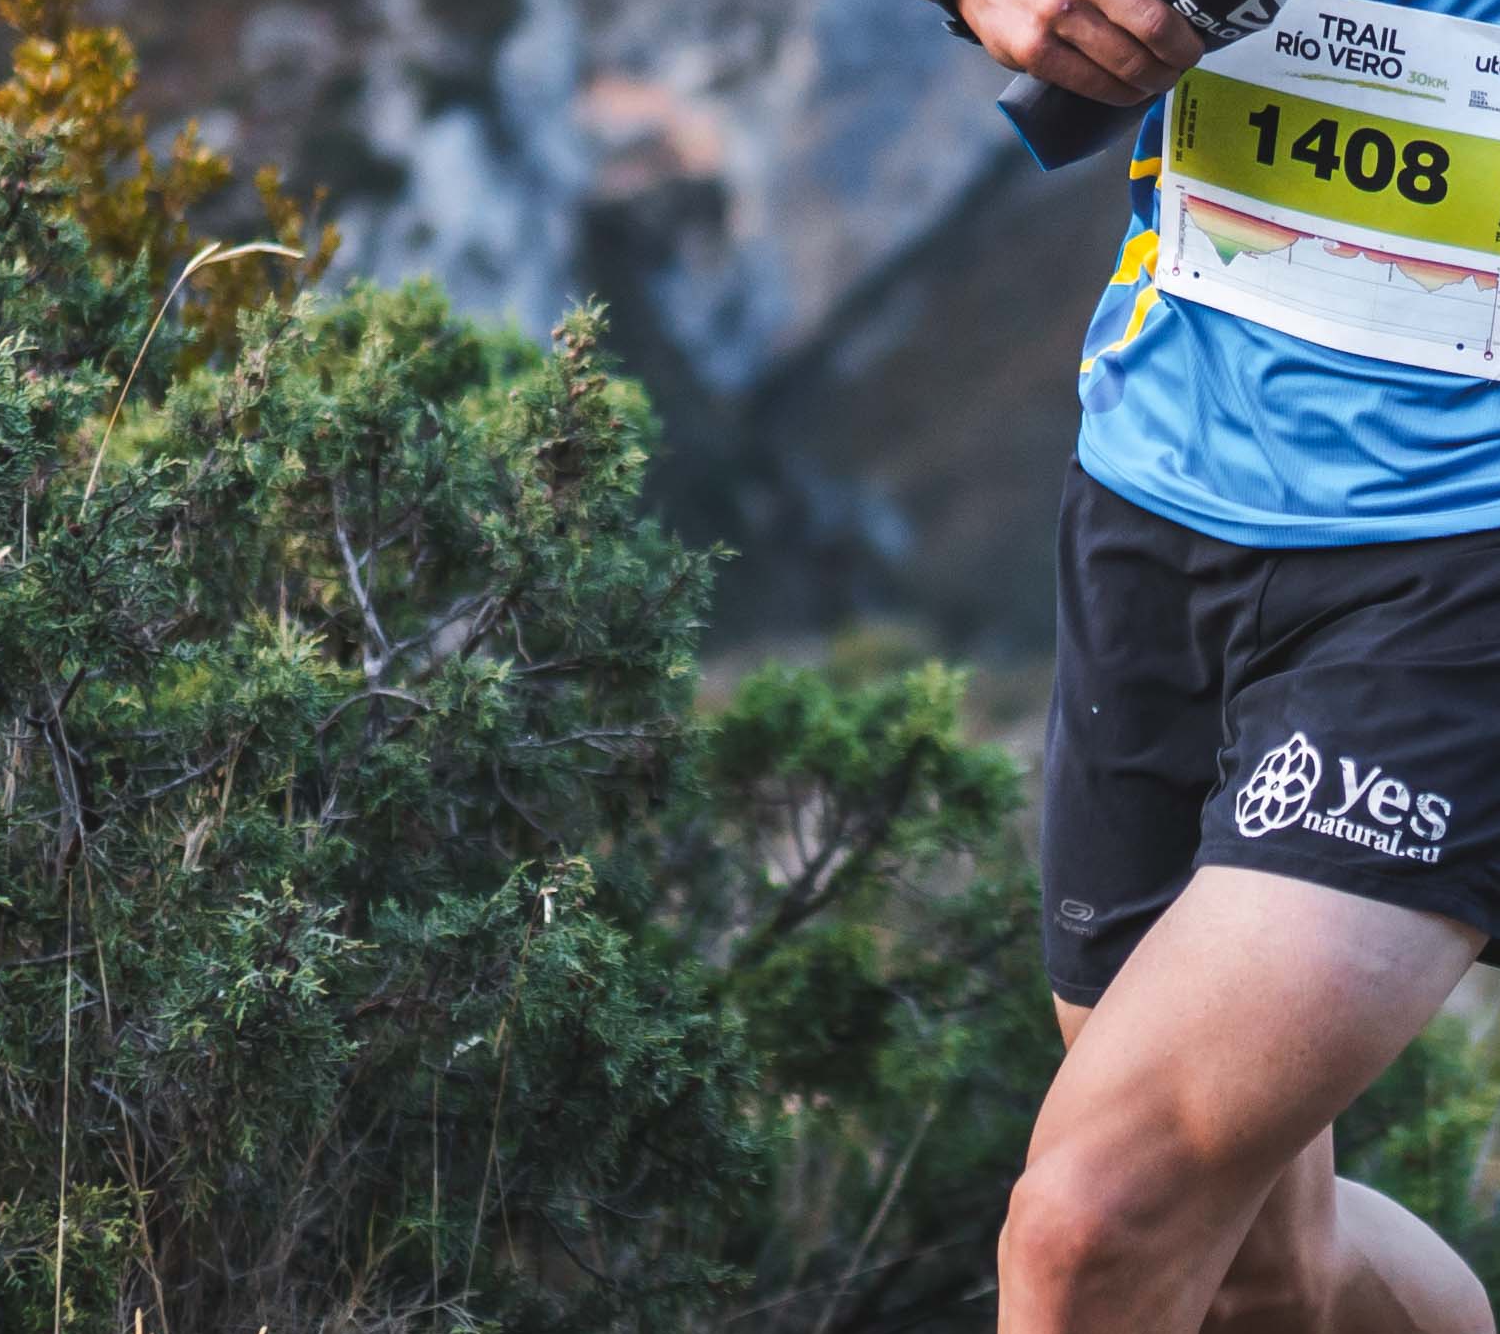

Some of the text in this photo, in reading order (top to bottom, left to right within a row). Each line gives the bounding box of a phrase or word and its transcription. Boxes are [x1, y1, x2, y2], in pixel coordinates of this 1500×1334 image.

[1275, 31, 1403, 79] RÍO VERO
[1318, 13, 1406, 55] TRAIL
[1248, 103, 1450, 205] 1408
